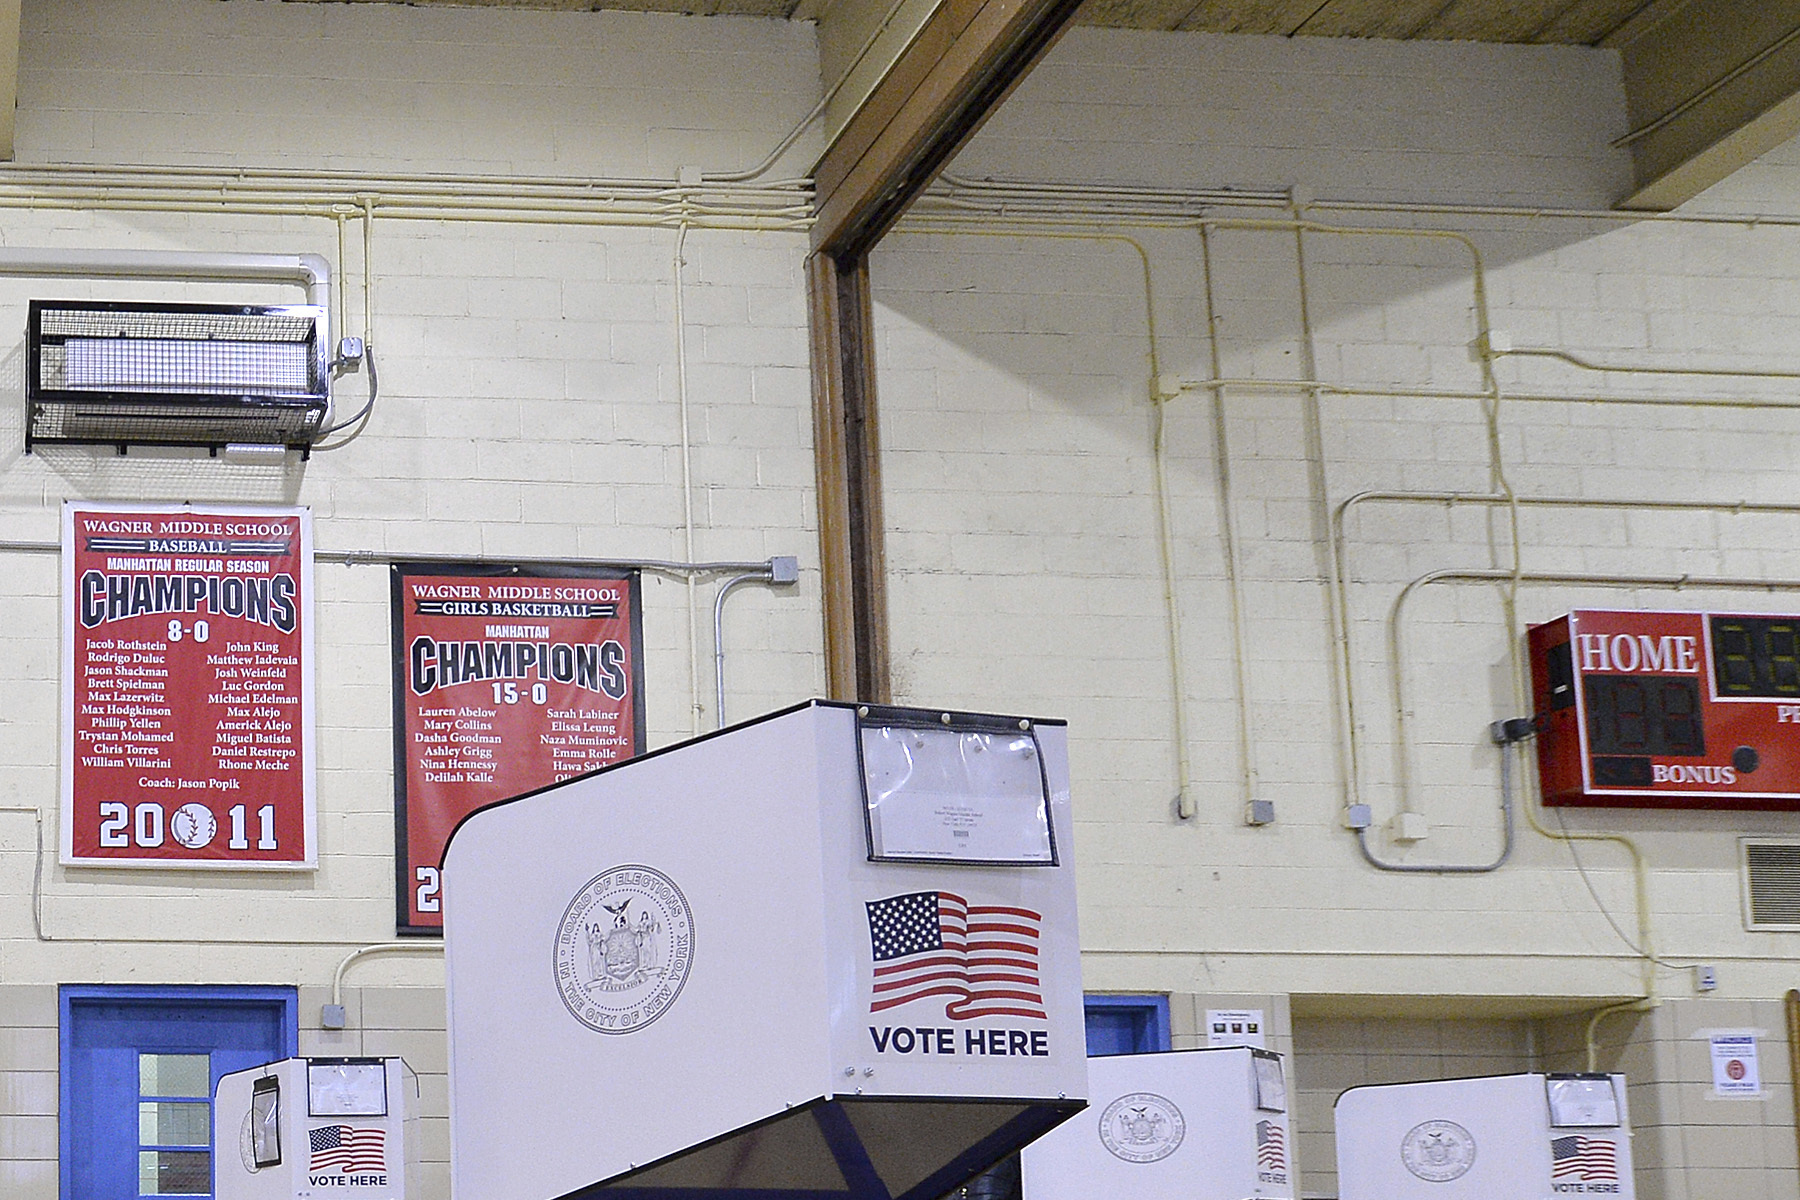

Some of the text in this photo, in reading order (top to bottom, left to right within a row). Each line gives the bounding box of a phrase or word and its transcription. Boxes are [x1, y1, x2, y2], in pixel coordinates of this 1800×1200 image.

[83, 520, 293, 536] WAGNER MIDDLE SCHOOL
[149, 540, 228, 554] BASEBALL
[107, 557, 270, 574] MANHATTAN REGULAR SEASON
[412, 585, 621, 601] WAGNER MIDDLE SCHOOL
[80, 569, 296, 635] CHAMPIONS
[441, 603, 592, 618] GIRLS BASKETBALL
[485, 624, 550, 638] MANHATTAN
[86, 639, 167, 651] Jacob Rothstein
[225, 642, 279, 654] John King
[87, 652, 131, 665] Rodrigo
[1576, 633, 1700, 673] HOME
[206, 655, 253, 665] Matthew
[84, 665, 169, 677] Jason Shackman
[215, 667, 287, 679] Josh Weinfeld
[410, 635, 627, 701] CHAMPIONS
[87, 678, 165, 691] Brett Spielman
[222, 680, 285, 691] Luc Gordon
[88, 691, 111, 701] Max
[208, 694, 298, 704] Michael Edelman
[81, 704, 172, 717] Max Hodgkinson
[227, 706, 281, 720] Max Alejo
[418, 707, 497, 717] Lauren Abelow
[546, 708, 619, 720] Sarah Labiner
[91, 717, 161, 730] Phillip Yellen
[216, 720, 292, 733] Americk Alejo
[424, 719, 492, 732] Mary Collins
[551, 721, 616, 735] Elissa Leung
[78, 730, 174, 743] Trystan Mohamed
[216, 733, 292, 746] Miguel Batista
[415, 732, 502, 744] Dasha Goodman
[540, 734, 628, 746] Naza Muminovic
[93, 744, 159, 755] Chris Torres
[212, 746, 297, 760] Daniel Restrepo
[424, 745, 493, 759] Ashley Grigg
[552, 748, 617, 759] Emma Rolle
[81, 757, 172, 768] William Villarini
[218, 759, 290, 770] Rhone Meche
[420, 759, 498, 772] Nina Hennessy
[553, 761, 582, 771] Hawa
[425, 772, 494, 783] Delilah Kalle
[1652, 764, 1737, 785] BONUS
[138, 777, 241, 792] Coach: Jason Popik
[99, 801, 278, 851] 20 11
[561, 872, 683, 945] BOARD OF ELECTIONS
[559, 933, 688, 1027] IN THE CITY OF NEW YORK
[868, 1026, 1049, 1057] VOTE HERE
[308, 1175, 388, 1187] VOTE HERE
[1551, 1183, 1619, 1193] VOTE HERE
